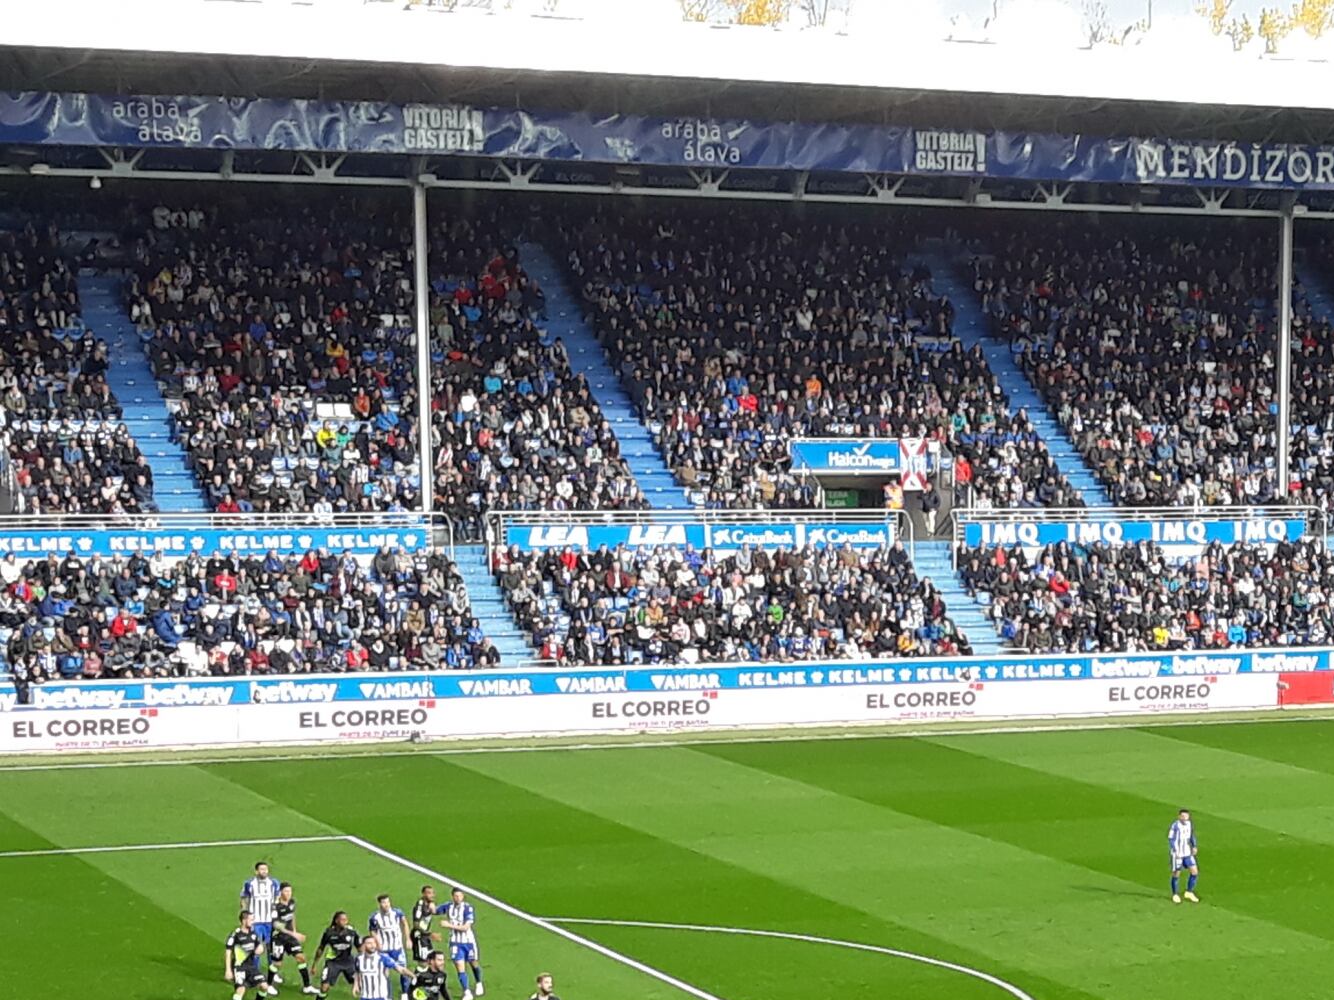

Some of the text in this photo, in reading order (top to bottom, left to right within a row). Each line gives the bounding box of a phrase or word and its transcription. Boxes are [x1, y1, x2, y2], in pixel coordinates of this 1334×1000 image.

[662, 120, 722, 140] araba
[684, 141, 741, 163] álava
[327, 532, 399, 549] KELME
[528, 525, 589, 547] LEA
[627, 525, 687, 546] LEA
[982, 523, 1040, 546] IMQ
[1068, 522, 1123, 545] IMQ
[1152, 521, 1206, 544] IMQ
[1233, 520, 1286, 543] IMQ
[110, 535, 185, 551] KELME
[220, 534, 293, 550] KELME
[1002, 664, 1066, 679] KELME
[1251, 655, 1318, 674] betway
[738, 669, 806, 687] KELME
[828, 668, 894, 684] KELME
[866, 691, 976, 709] EL CORREO
[1109, 684, 1210, 702] EL CORREO
[593, 700, 711, 718] EL CORREO
[13, 718, 150, 738] EL CORREO
[300, 709, 428, 729] EL CORREO
